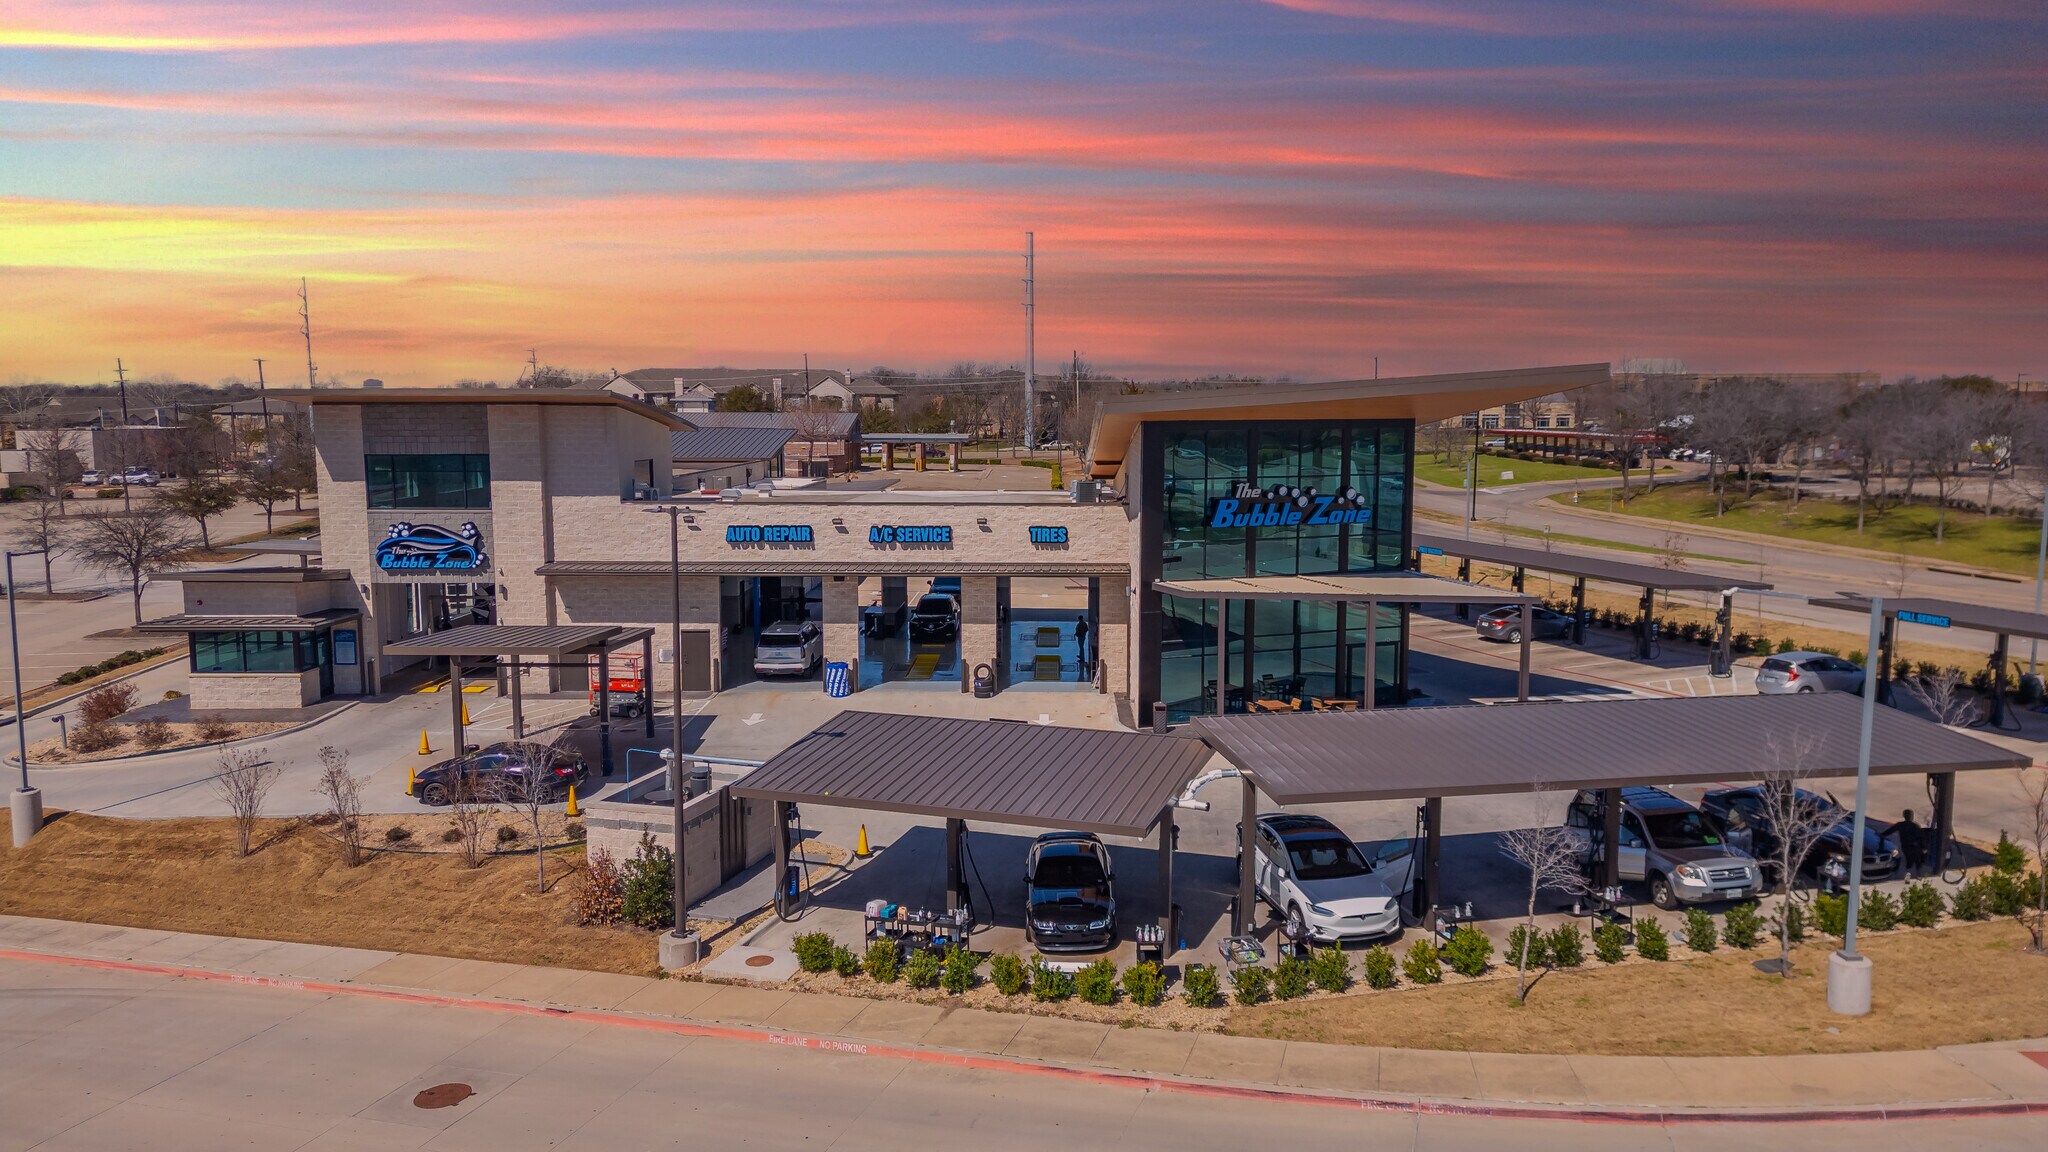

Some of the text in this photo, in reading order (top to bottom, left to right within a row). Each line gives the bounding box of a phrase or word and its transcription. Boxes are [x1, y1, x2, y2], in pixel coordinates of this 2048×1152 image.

[1235, 482, 1262, 498] The
[1211, 496, 1372, 528] Bubble Zone
[727, 526, 811, 542] AUTO REPAIR
[870, 526, 950, 543] A/C SERVICE
[1030, 527, 1067, 543] TIRES
[380, 552, 470, 568] Bubble Zone
[1898, 611, 1950, 627] FULL SERVICE
[768, 1034, 867, 1054] FIRE LANE NO PARKING
